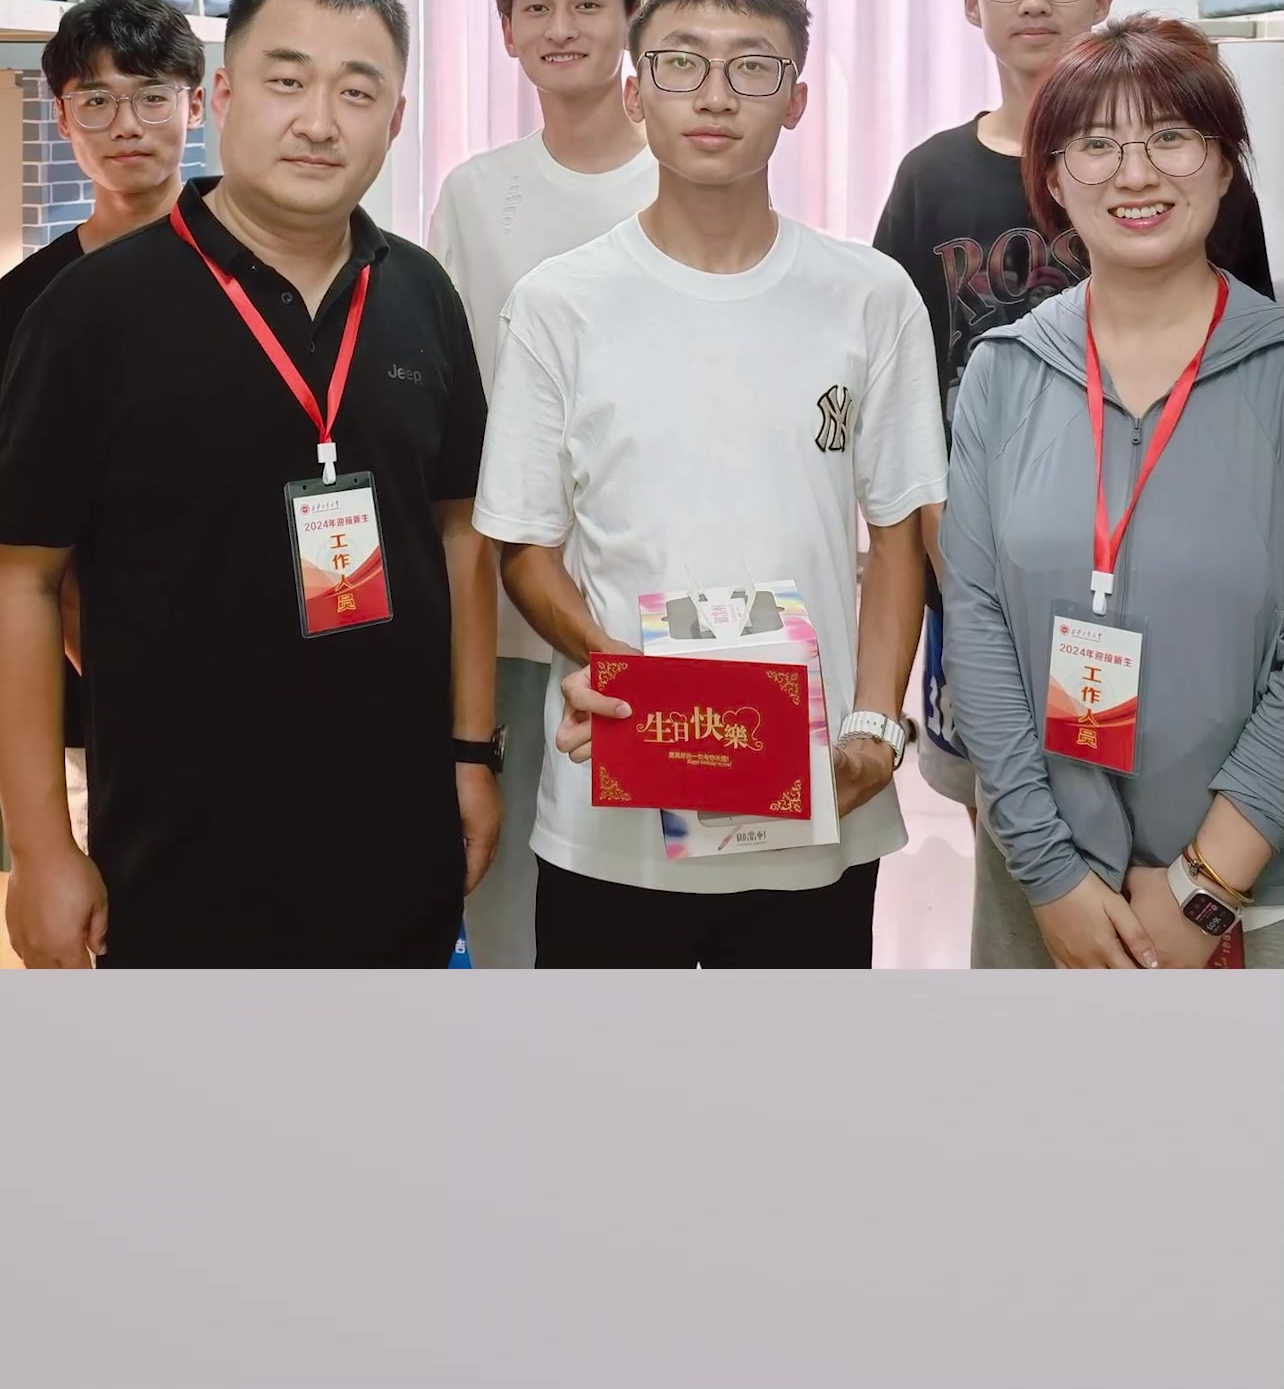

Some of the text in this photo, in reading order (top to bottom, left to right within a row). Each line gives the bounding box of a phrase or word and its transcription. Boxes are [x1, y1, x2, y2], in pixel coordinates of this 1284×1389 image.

[388, 364, 422, 385] Jeep
[330, 533, 356, 613] 工作人员
[1076, 665, 1102, 749] 工作人员
